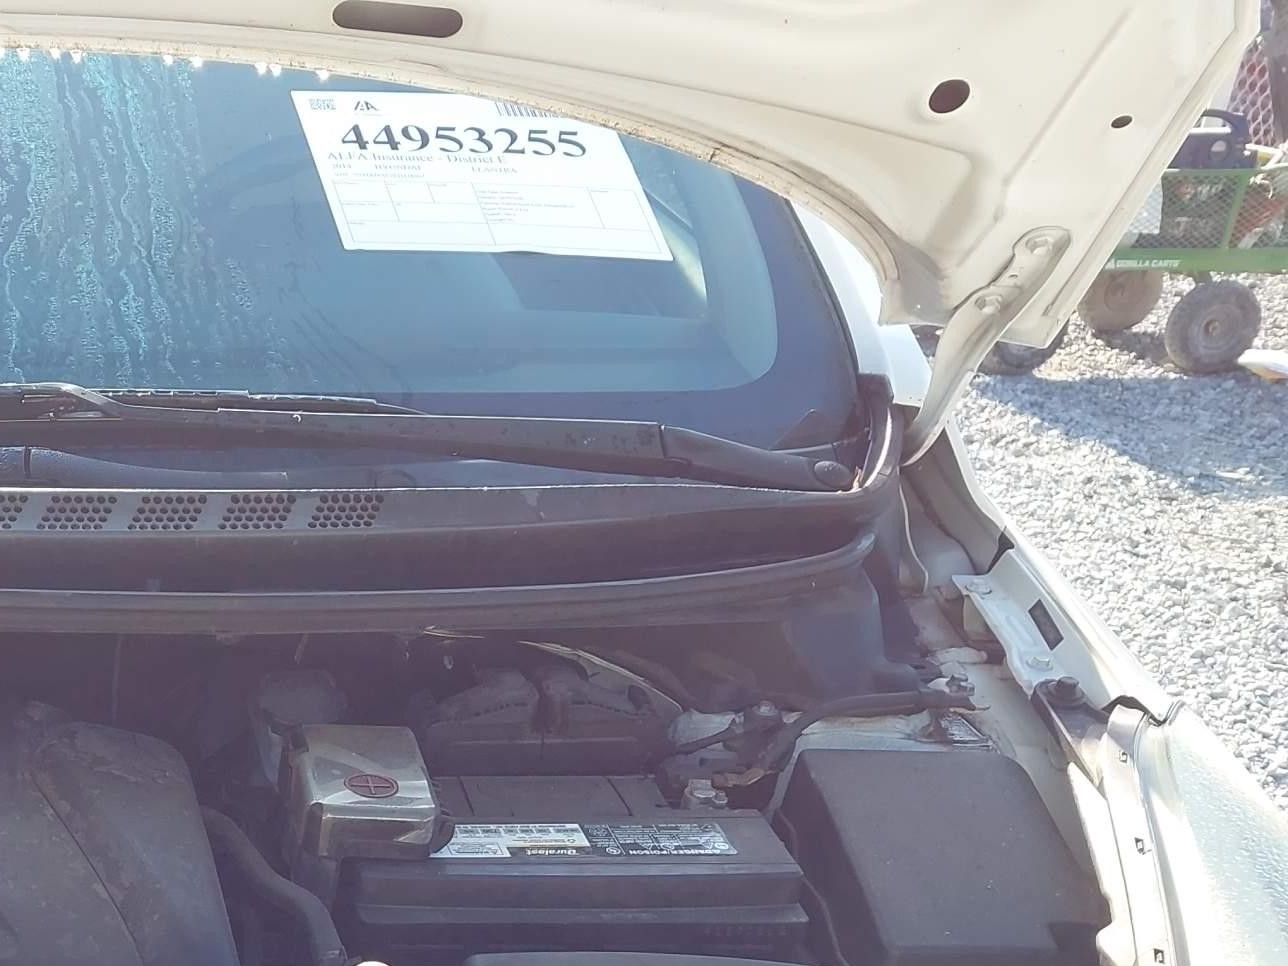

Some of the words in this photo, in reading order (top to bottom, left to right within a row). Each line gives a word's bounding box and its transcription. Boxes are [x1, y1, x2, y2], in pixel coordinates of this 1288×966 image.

[341, 123, 587, 158] 44953255
[372, 153, 433, 163] Insurance
[447, 155, 493, 164] District
[526, 848, 577, 857] Duralast
